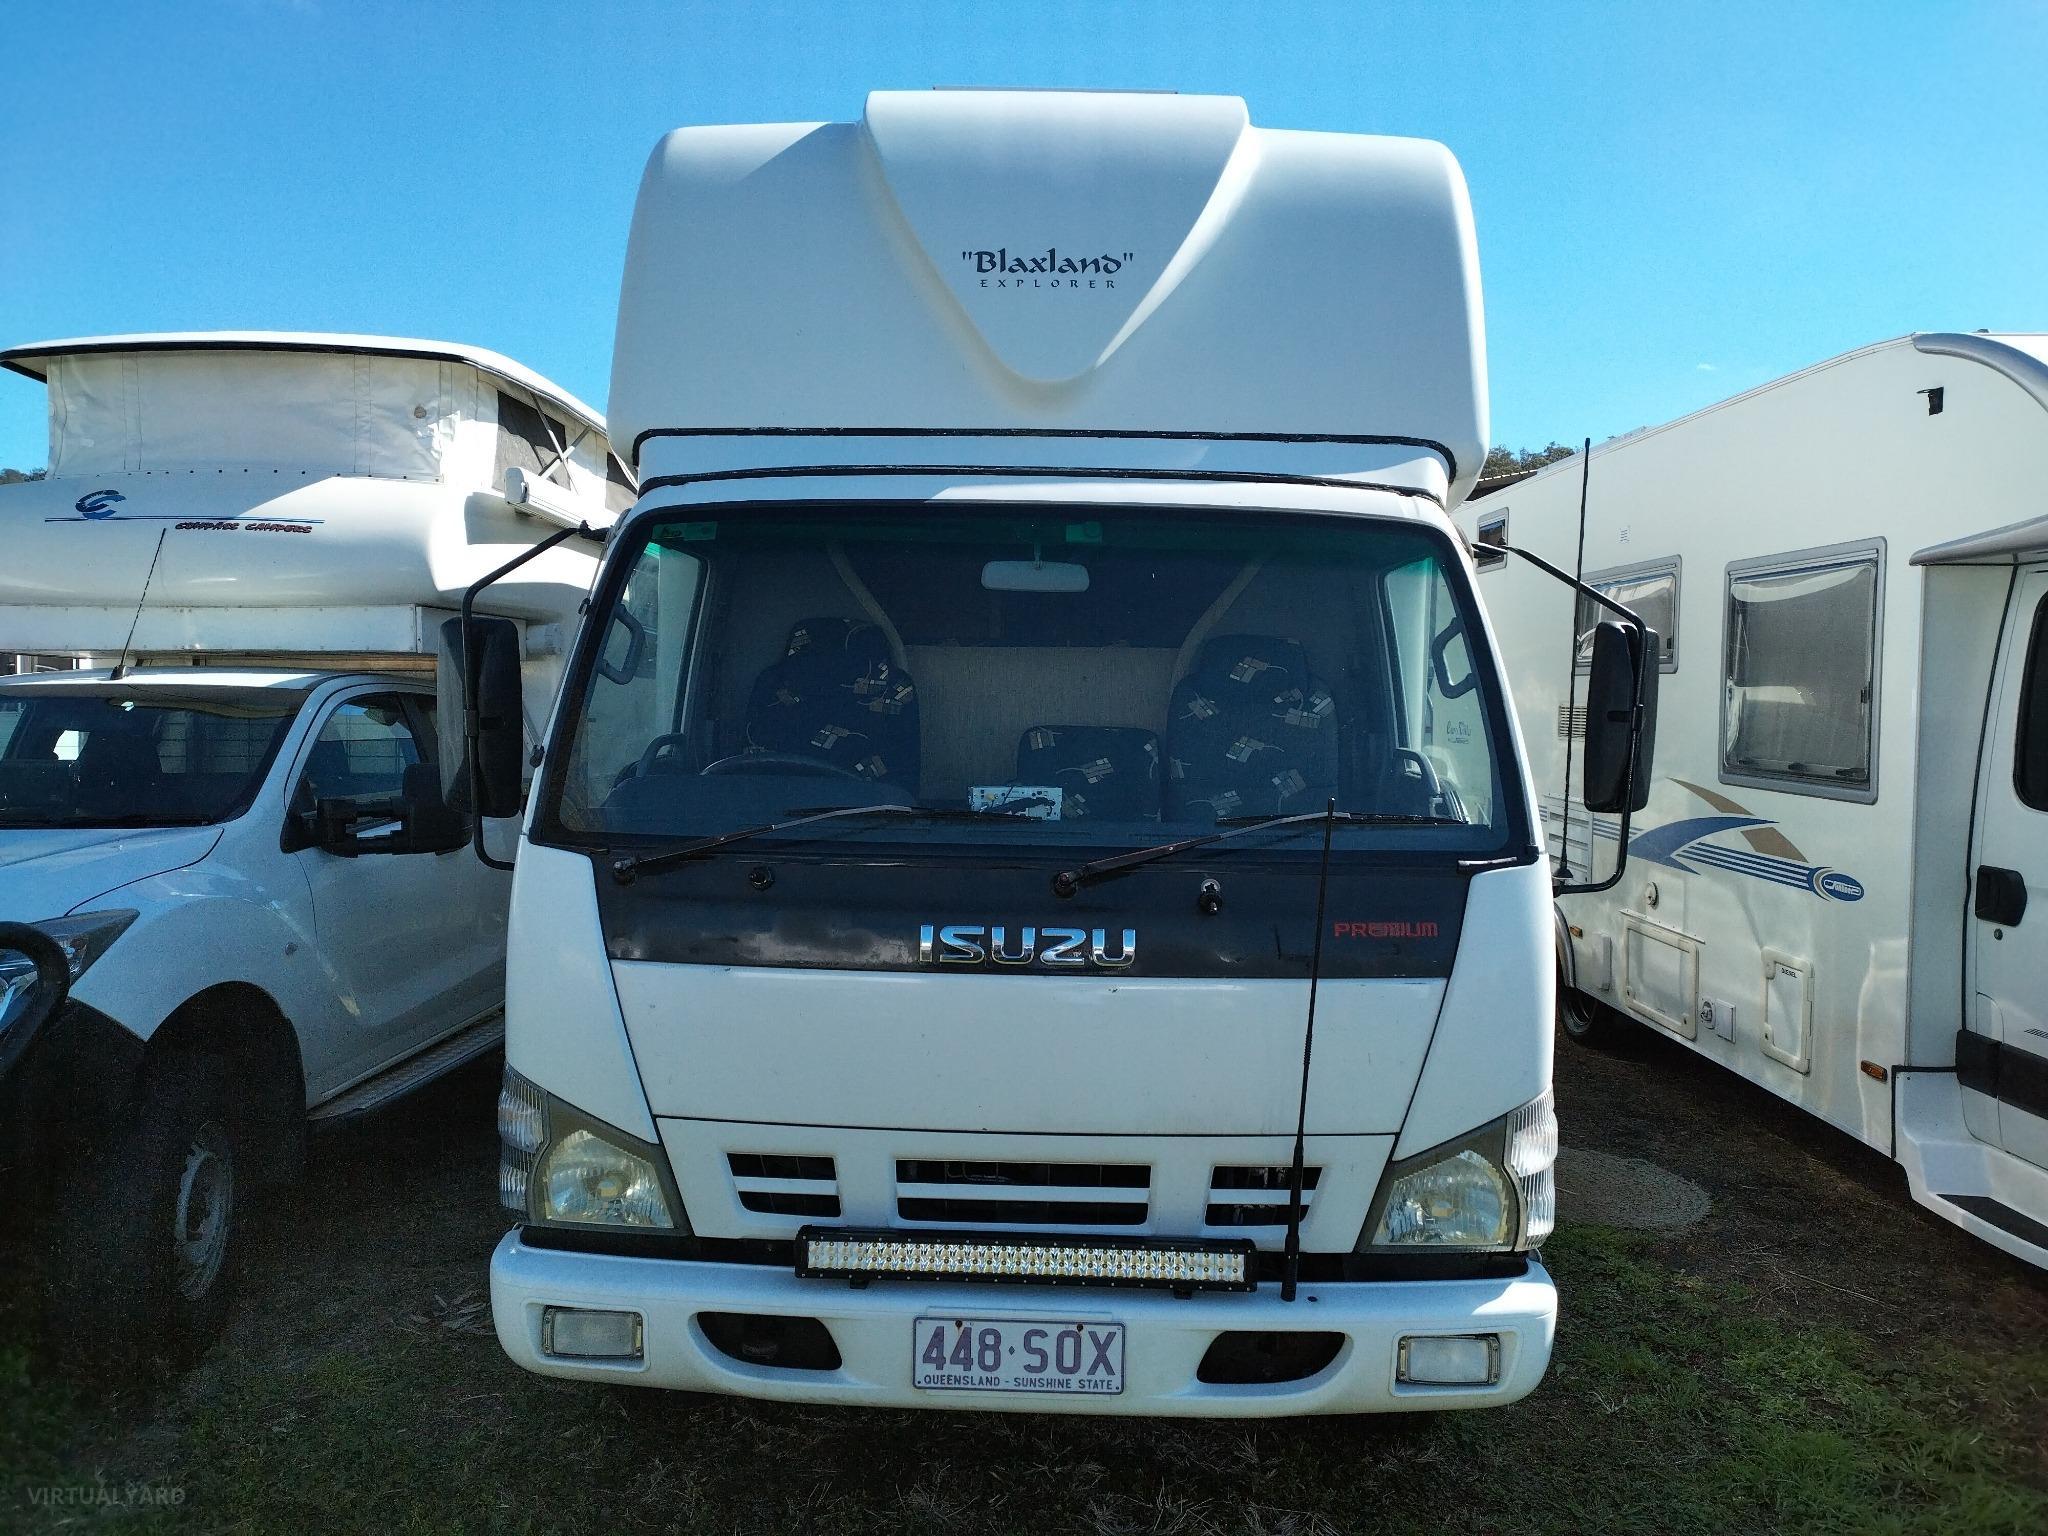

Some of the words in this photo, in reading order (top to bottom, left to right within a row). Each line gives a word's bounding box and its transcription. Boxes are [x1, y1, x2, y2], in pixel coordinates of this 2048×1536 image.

[980, 279, 1115, 289] EXPLORER
[174, 522, 240, 530] COMPASS
[245, 522, 313, 534] CAMPERS
[1334, 921, 1438, 937] PREMIUM
[919, 924, 1136, 968] ISUZU
[923, 1374, 1000, 1387] QUEENSLAND
[1013, 1377, 1072, 1389] SUNSHINE
[1078, 1379, 1113, 1390] STATE
